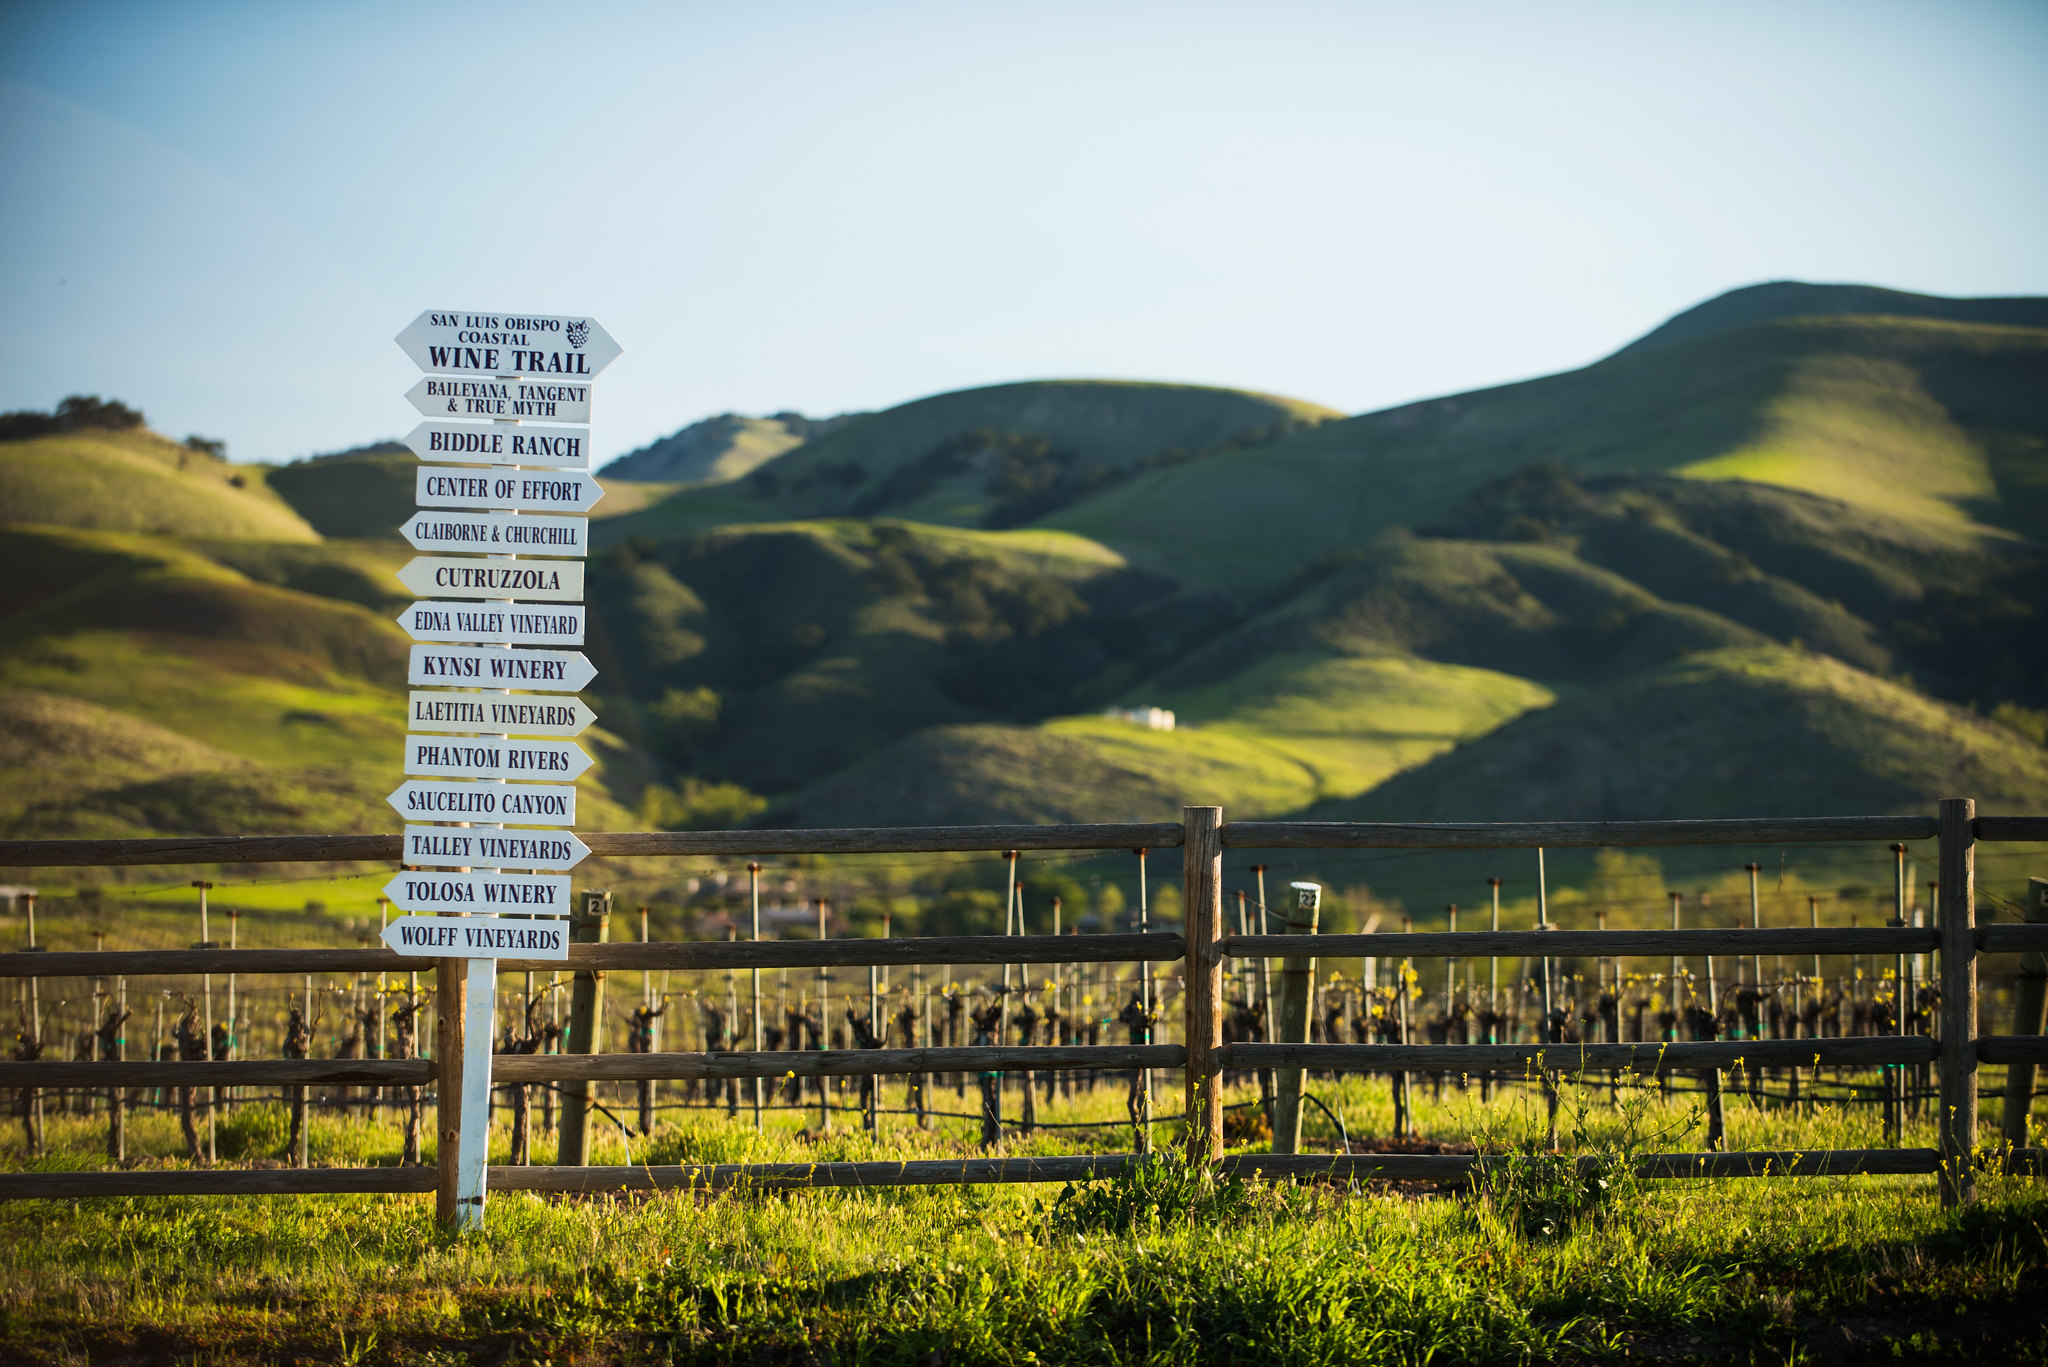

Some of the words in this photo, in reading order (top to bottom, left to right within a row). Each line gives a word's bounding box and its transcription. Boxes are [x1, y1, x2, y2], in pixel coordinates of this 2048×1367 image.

[431, 314, 459, 328] SAN
[466, 316, 498, 329] LUIS
[505, 318, 560, 332] OBISPO
[458, 331, 530, 346] COASTAL
[429, 346, 500, 370] WINE
[512, 350, 591, 374] TRAIL
[427, 381, 511, 401] BAILEYANA,
[518, 386, 586, 402] TANGENT
[448, 398, 458, 413] &
[465, 399, 505, 414] TRUE
[513, 401, 556, 416] MYTH
[430, 431, 503, 454] BIDDLE
[512, 436, 581, 457] RANCH
[427, 477, 488, 497] CENTER
[495, 480, 515, 499] OF
[522, 481, 581, 501] EFFORT
[416, 522, 487, 542] CLAIBORNE
[491, 526, 500, 542] &
[505, 526, 577, 545] CHURCHILL
[436, 567, 560, 590] CUTRUZZOLA
[415, 611, 450, 631] EDNA
[457, 613, 505, 633] VALLEY
[511, 614, 577, 635] VINEYARD
[424, 656, 480, 676] KYNSI
[491, 659, 567, 680] WINERY
[416, 701, 484, 722] LAETITIA
[492, 704, 576, 726] VINEYARDS
[417, 746, 500, 768] PHANTOM
[508, 749, 569, 771] RIVERS
[408, 790, 495, 812] SAUCELITO
[502, 794, 567, 815] CANYON
[412, 835, 472, 856] TALLEY
[480, 838, 571, 860] VINEYARDS
[406, 881, 474, 902] TOLOSA
[484, 884, 557, 904] WINERY
[591, 900, 608, 913] 21
[401, 926, 458, 946] WOLFF
[466, 928, 560, 950] VINEYARDS
